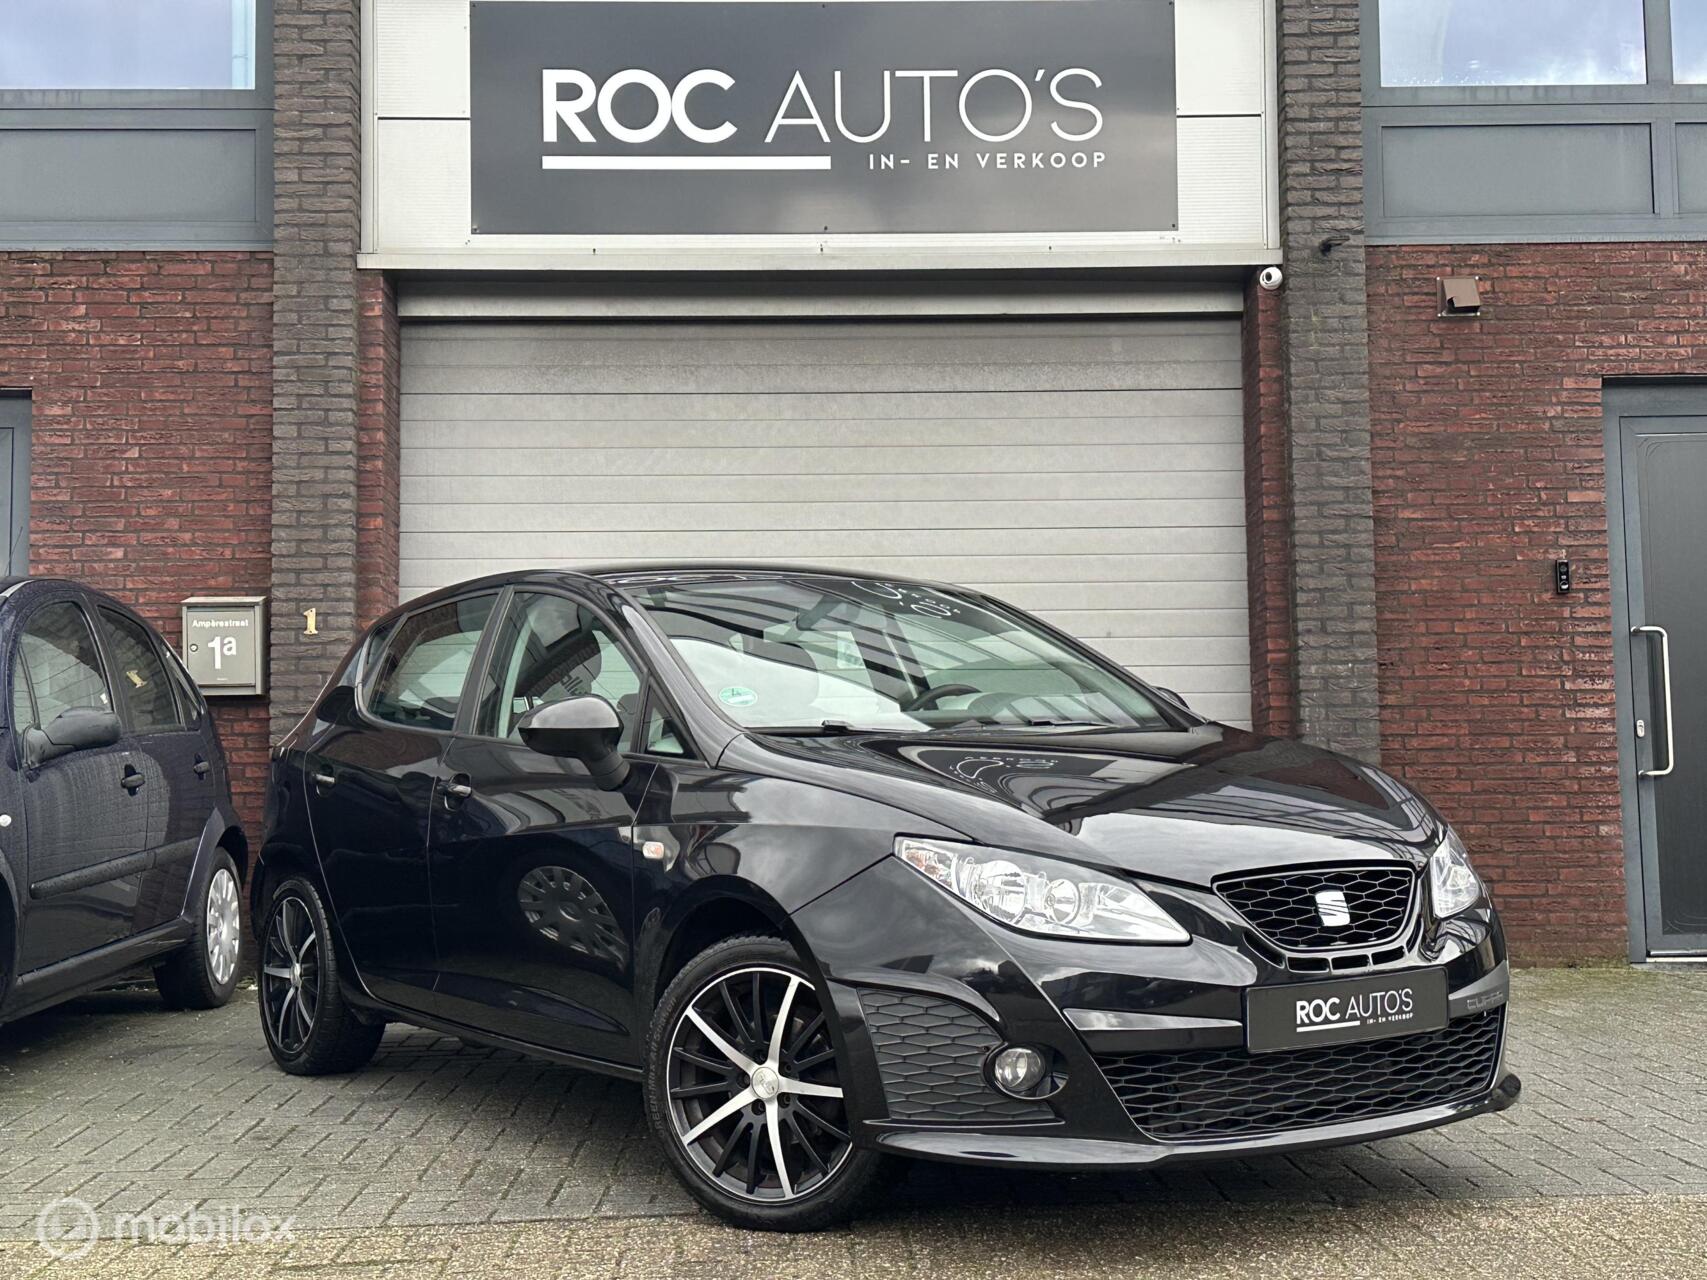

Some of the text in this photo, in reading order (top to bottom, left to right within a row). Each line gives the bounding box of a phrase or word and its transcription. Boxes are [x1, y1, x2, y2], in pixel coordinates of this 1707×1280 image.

[543, 69, 1102, 143] ROC AUTO'S
[870, 152, 1105, 169] IN- EN VERKOOP
[303, 607, 319, 635] 1
[208, 636, 237, 670] 1a
[1296, 988, 1413, 1025] ROC AUTO'S
